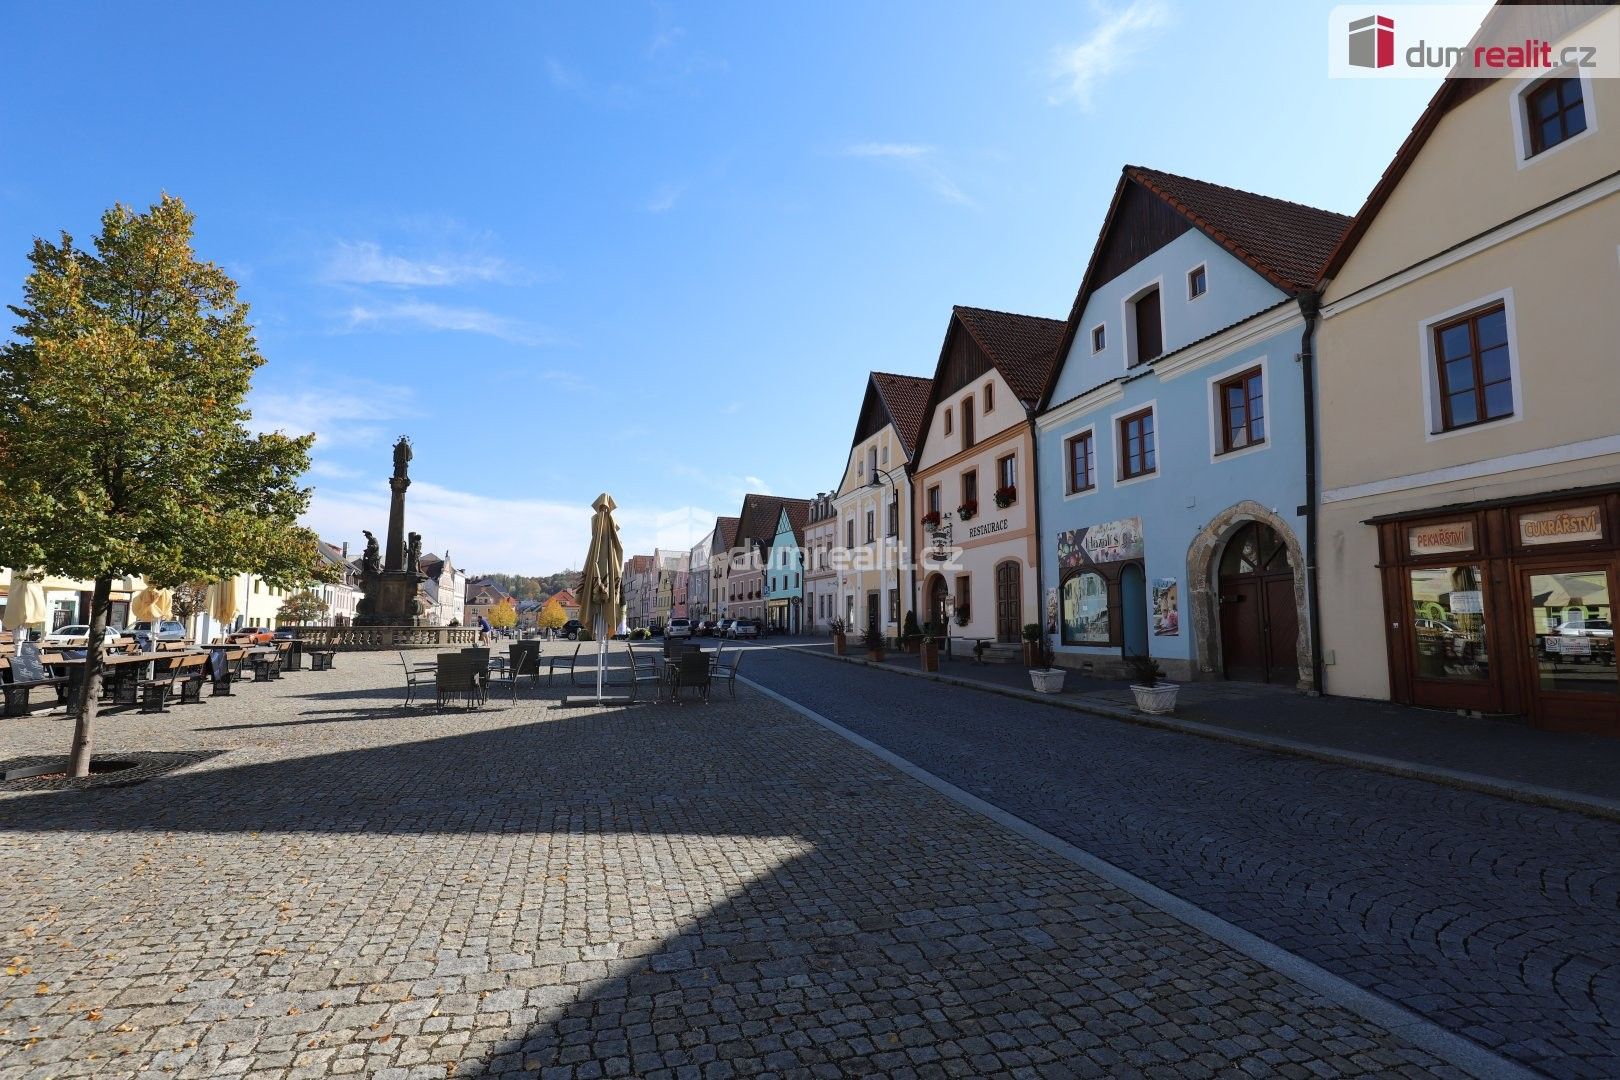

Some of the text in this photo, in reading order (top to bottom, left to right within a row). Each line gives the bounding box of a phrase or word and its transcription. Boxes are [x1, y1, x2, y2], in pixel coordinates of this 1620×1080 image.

[969, 519, 1008, 537] RESTAURACE
[1525, 510, 1597, 537] CUKRÁŘSTVÍ
[1417, 526, 1465, 547] PEKAŘSTVÍ
